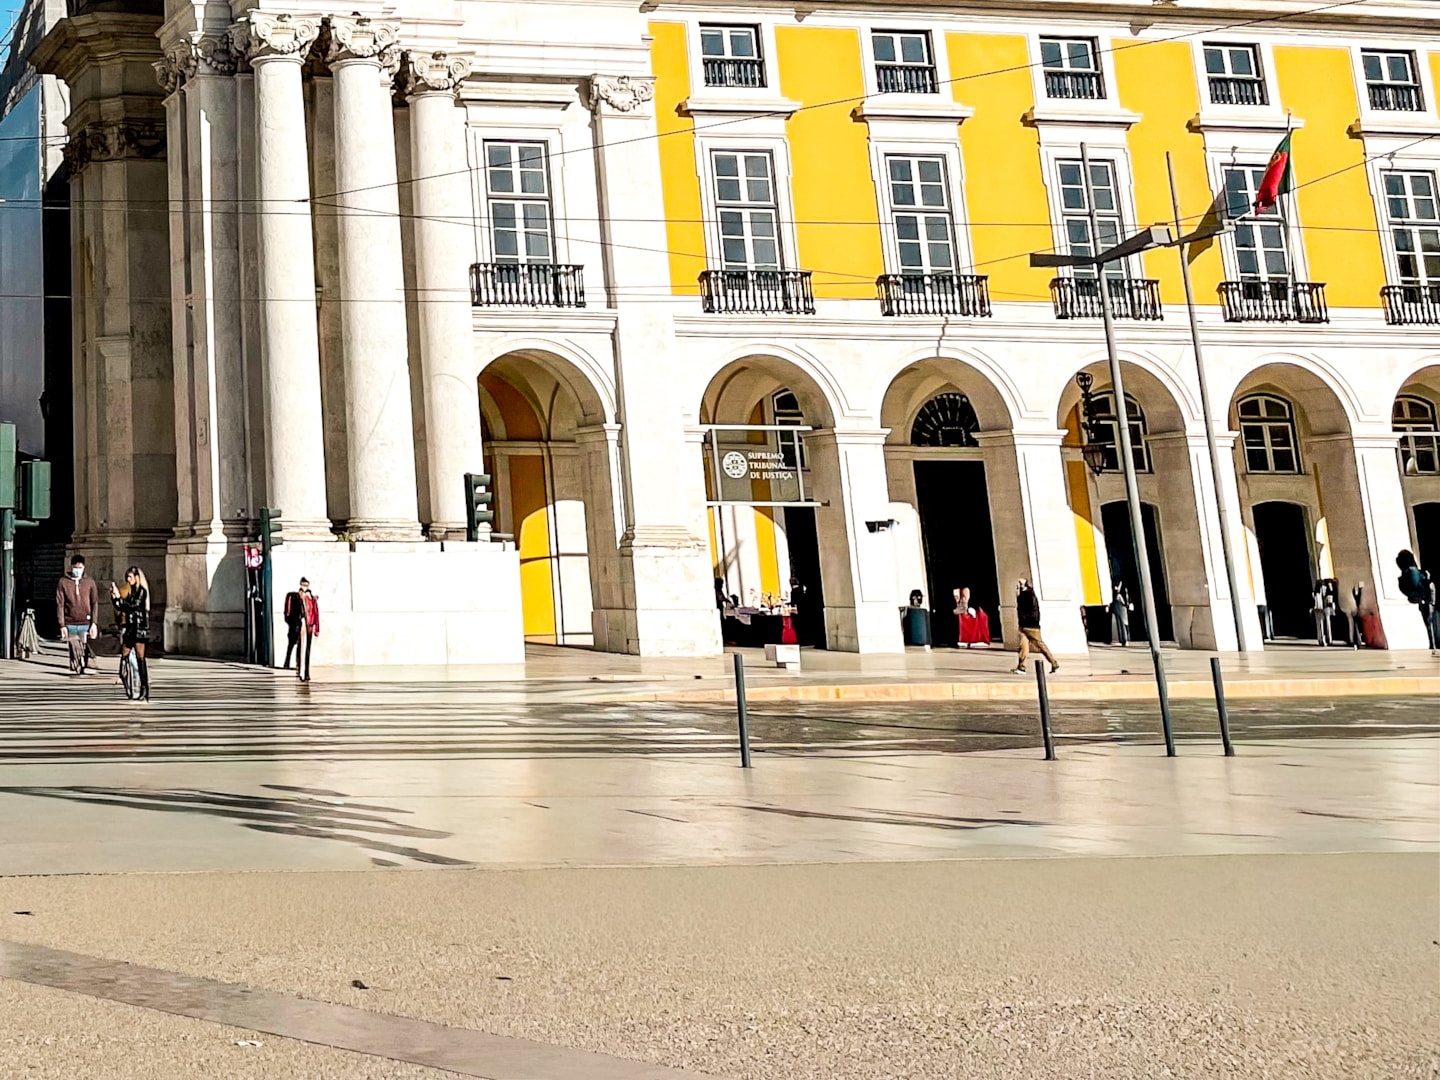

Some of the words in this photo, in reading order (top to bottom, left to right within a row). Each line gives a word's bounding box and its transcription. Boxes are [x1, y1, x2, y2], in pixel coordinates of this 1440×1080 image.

[747, 452, 785, 460] SUPREMO
[748, 461, 787, 470] TRIBUNAL
[750, 471, 761, 479] DE
[762, 471, 793, 480] JUSTIÇA
